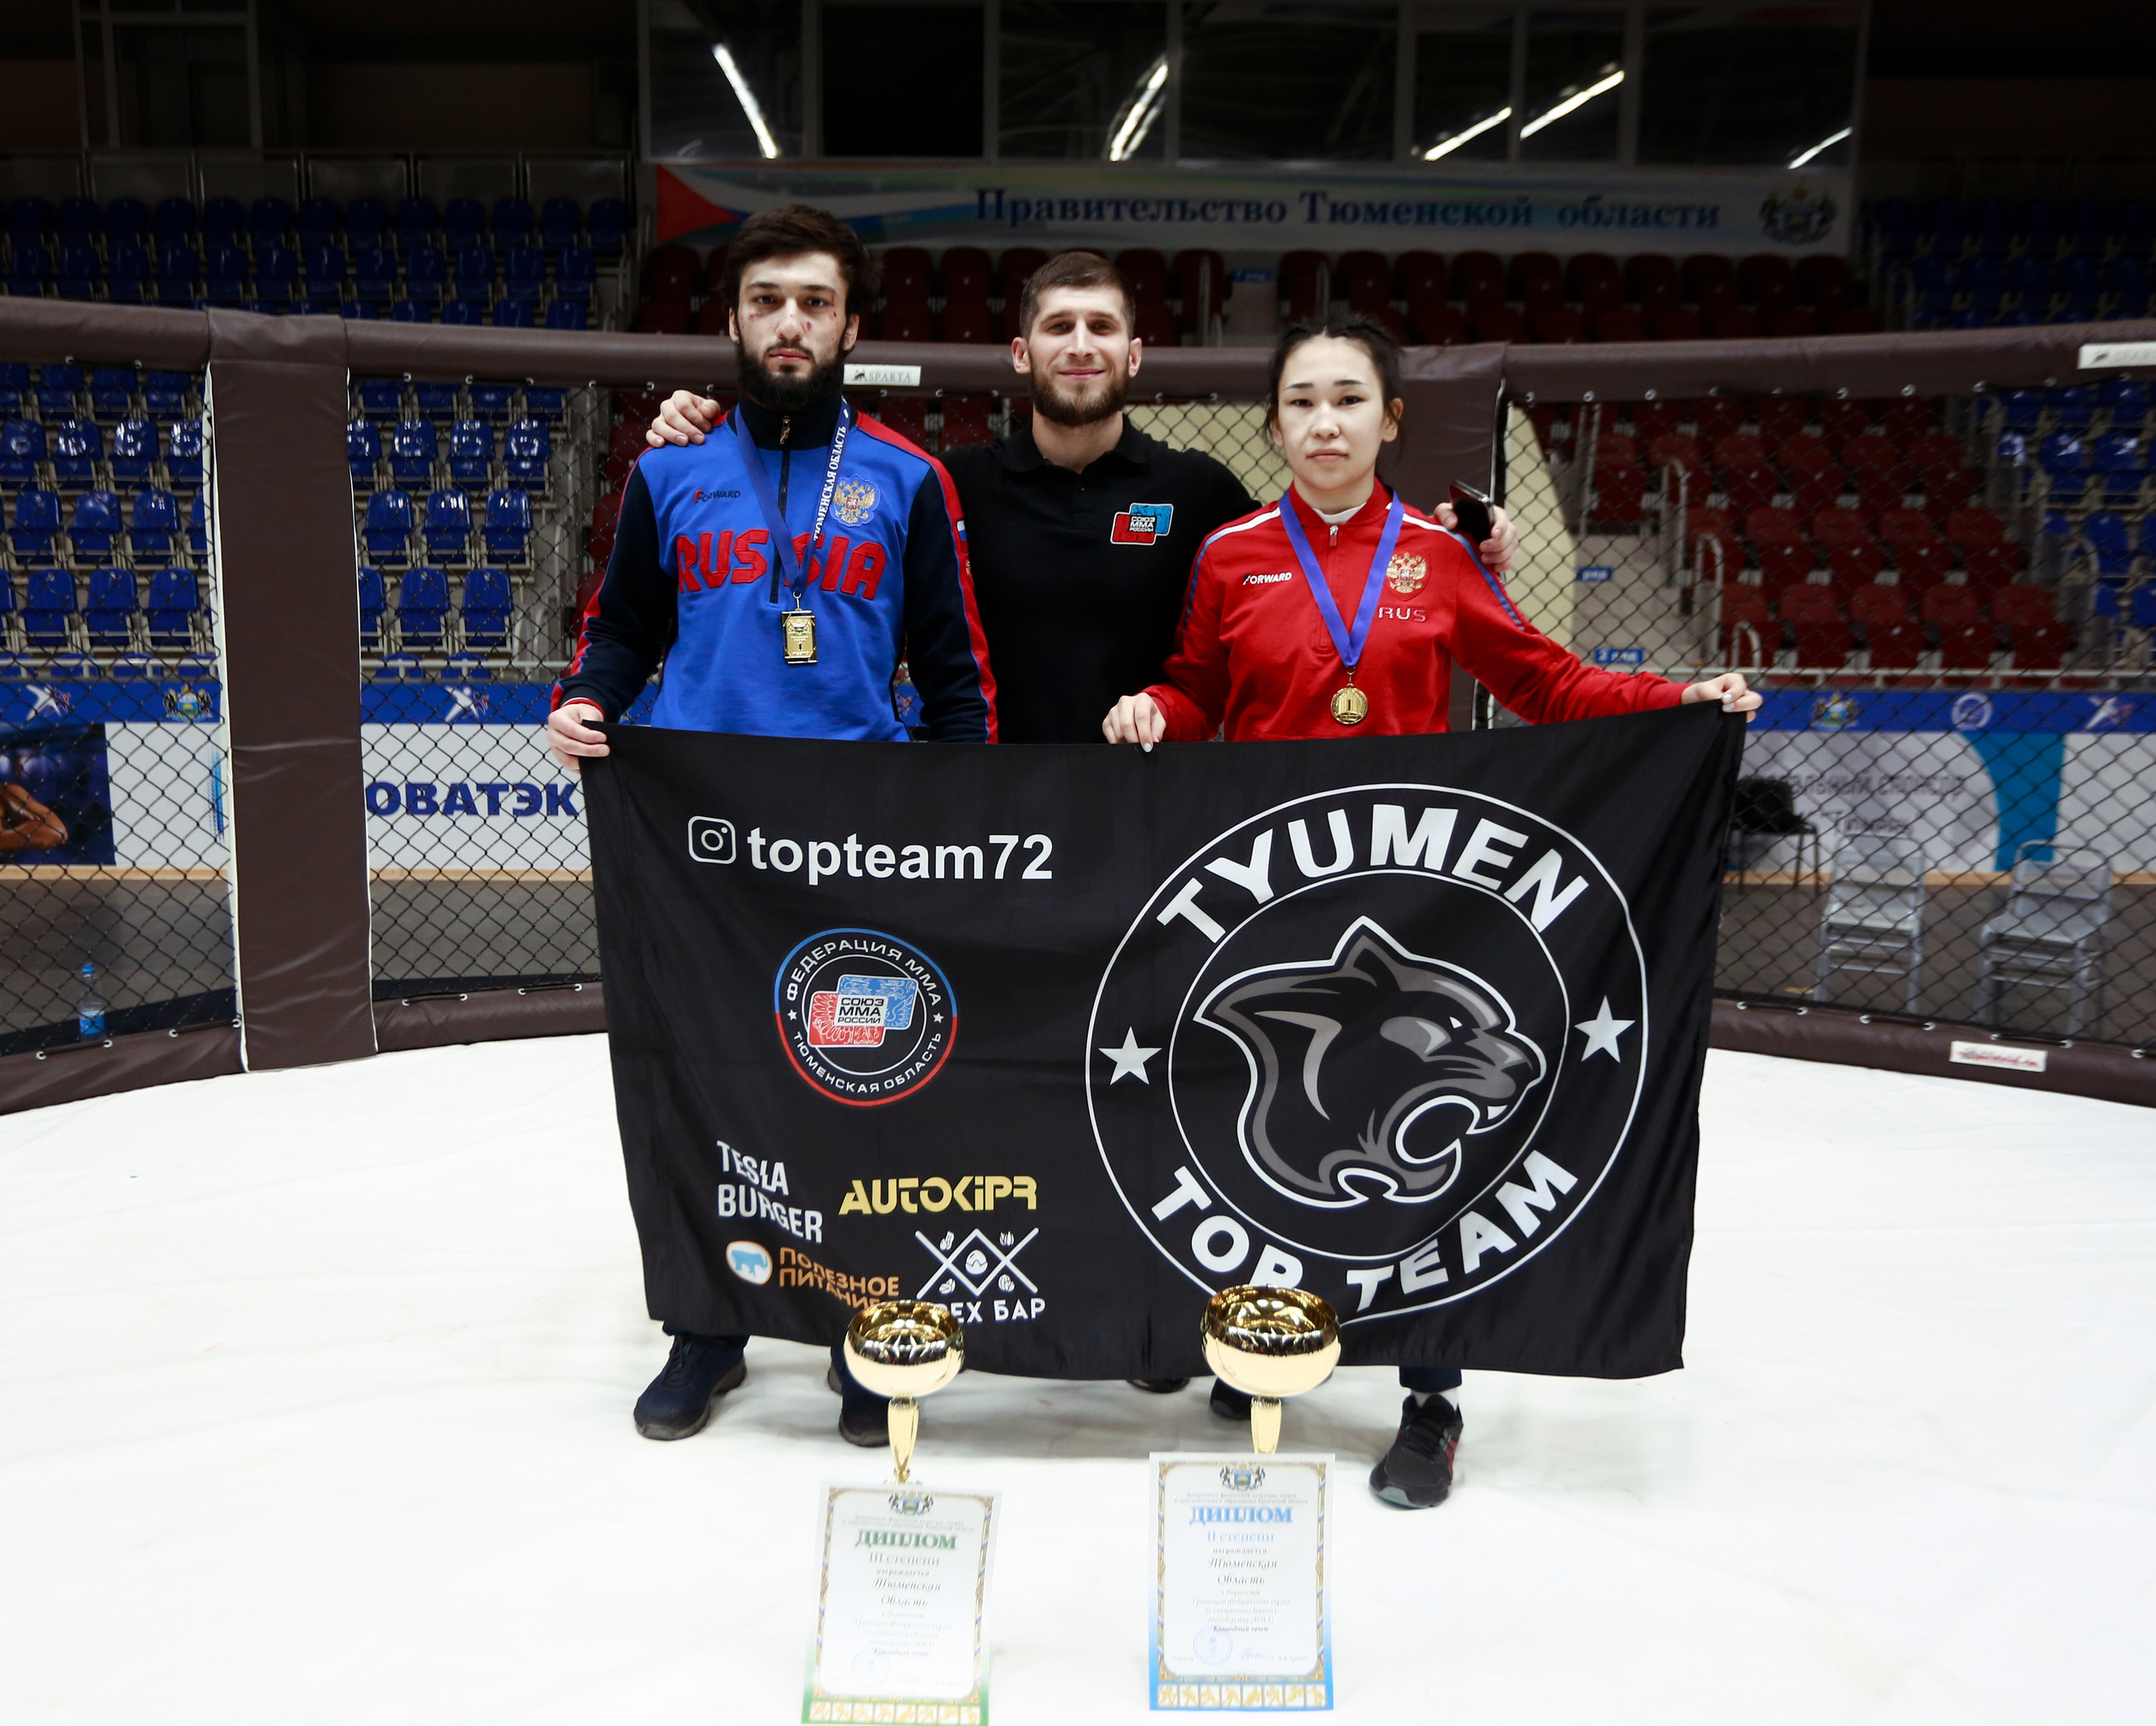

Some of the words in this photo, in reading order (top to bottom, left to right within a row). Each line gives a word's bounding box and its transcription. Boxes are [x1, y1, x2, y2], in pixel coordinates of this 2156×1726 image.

[974, 188, 1287, 224] Правительство
[1300, 190, 1534, 227] Тюменской
[1558, 195, 1719, 229] области
[868, 371, 911, 383] SPARTA
[813, 470, 837, 542] ТЮМЕНСКАЯ
[828, 425, 846, 471] ОБЛАСТЬ
[675, 528, 888, 601] RUSSIA
[1242, 572, 1293, 585] FORWARD
[1377, 606, 1427, 623] RUS
[747, 826, 1054, 886] topteam72
[1156, 804, 1589, 944] TYUMEN
[786, 939, 903, 1002] ФЕДЕРАЦИЯ
[905, 959, 942, 1007] ММА
[838, 1006, 882, 1017] ММА
[841, 997, 885, 1007] СОЮЗ
[792, 1031, 880, 1093] ТЮМЕНСКАЯ
[883, 1032, 942, 1090] ОБЛАСТЬ
[716, 1139, 790, 1196] TESLA
[718, 1184, 824, 1243] BURGER
[1151, 1166, 1304, 1290] TOP
[1347, 1149, 1578, 1310] TEAM
[779, 1246, 899, 1297] ПОЛЕЗНОЕ
[994, 1297, 1046, 1322] БАР
[1188, 1506, 1294, 1526] ДИПЛОМ
[854, 1529, 958, 1551] ДИПЛОМ
[1207, 1531, 1216, 1542] II
[1219, 1532, 1274, 1542] степени
[868, 1552, 883, 1563] III
[887, 1555, 941, 1566] степени
[1208, 1557, 1278, 1570] Тюменская
[1217, 1573, 1266, 1585] Область
